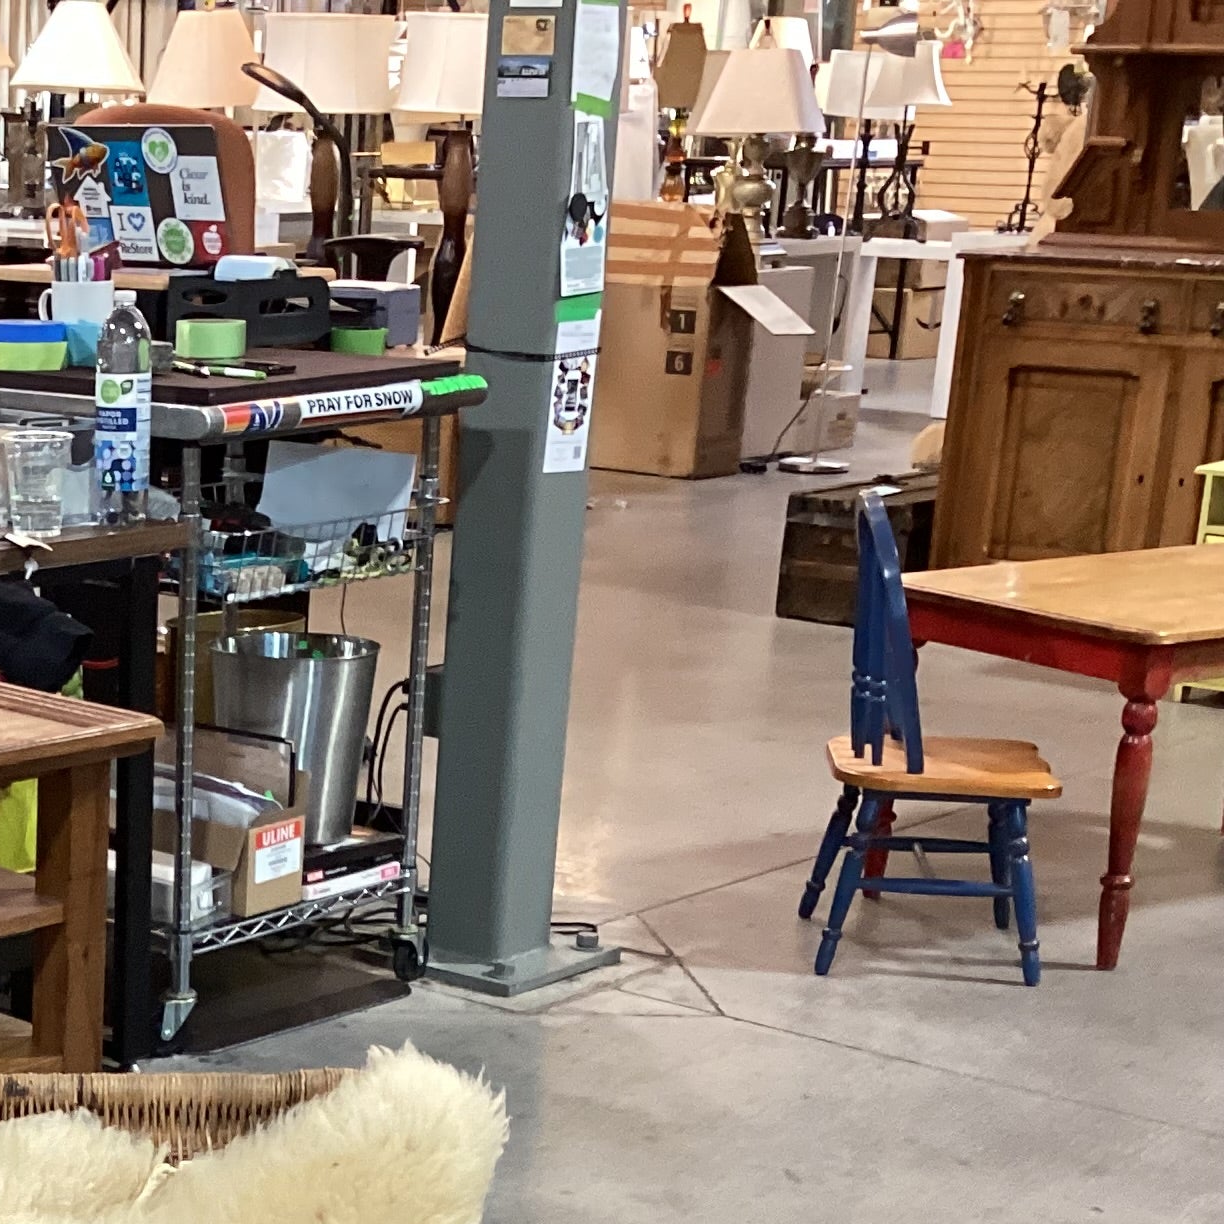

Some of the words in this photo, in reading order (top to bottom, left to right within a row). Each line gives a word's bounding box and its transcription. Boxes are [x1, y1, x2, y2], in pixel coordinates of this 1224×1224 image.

[181, 179, 191, 191] is
[116, 212, 126, 232] I
[678, 313, 686, 330] 1
[674, 354, 684, 372] 6
[306, 397, 342, 414] PRAY
[343, 394, 374, 410] FOR
[373, 389, 413, 407] SNOW
[262, 822, 296, 846] ULINE
